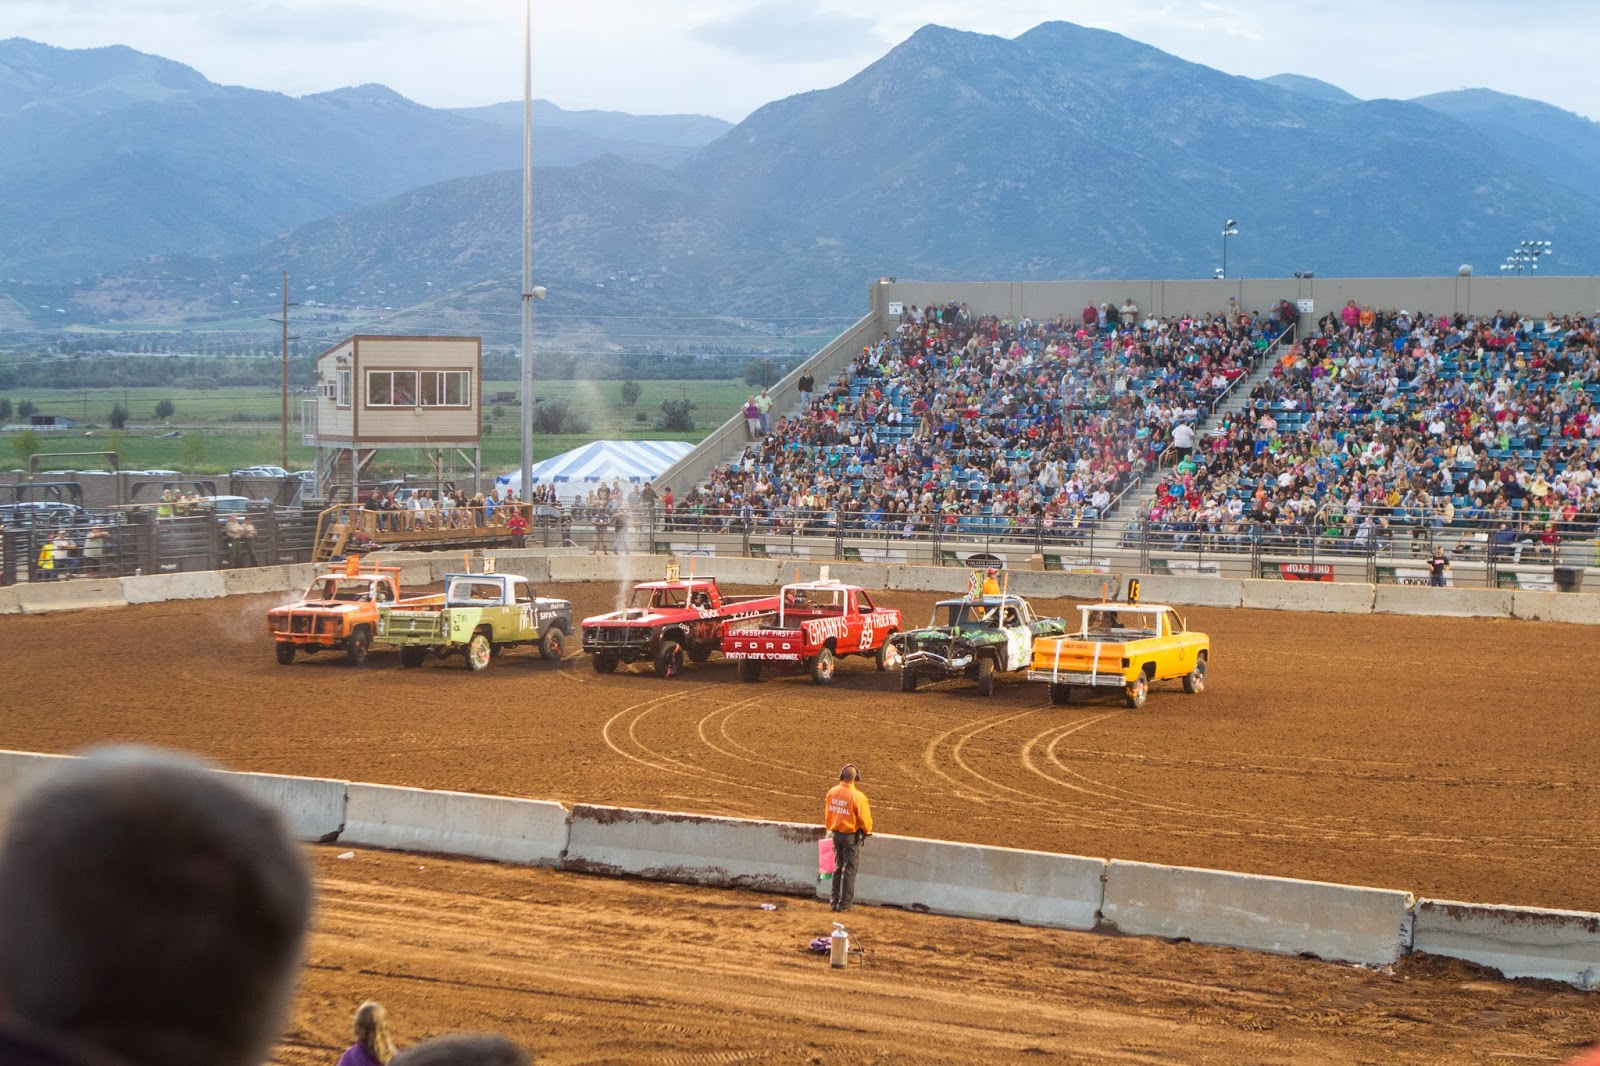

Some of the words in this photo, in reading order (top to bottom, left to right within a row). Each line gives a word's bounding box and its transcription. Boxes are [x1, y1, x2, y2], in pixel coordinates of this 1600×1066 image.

[1286, 564, 1310, 573] STOP
[1312, 564, 1330, 573] ONE
[1130, 580, 1140, 601] 13
[698, 609, 720, 619] CHUCK
[808, 617, 849, 646] GRANNYS
[859, 629, 873, 650] 69
[734, 641, 791, 650] FORD
